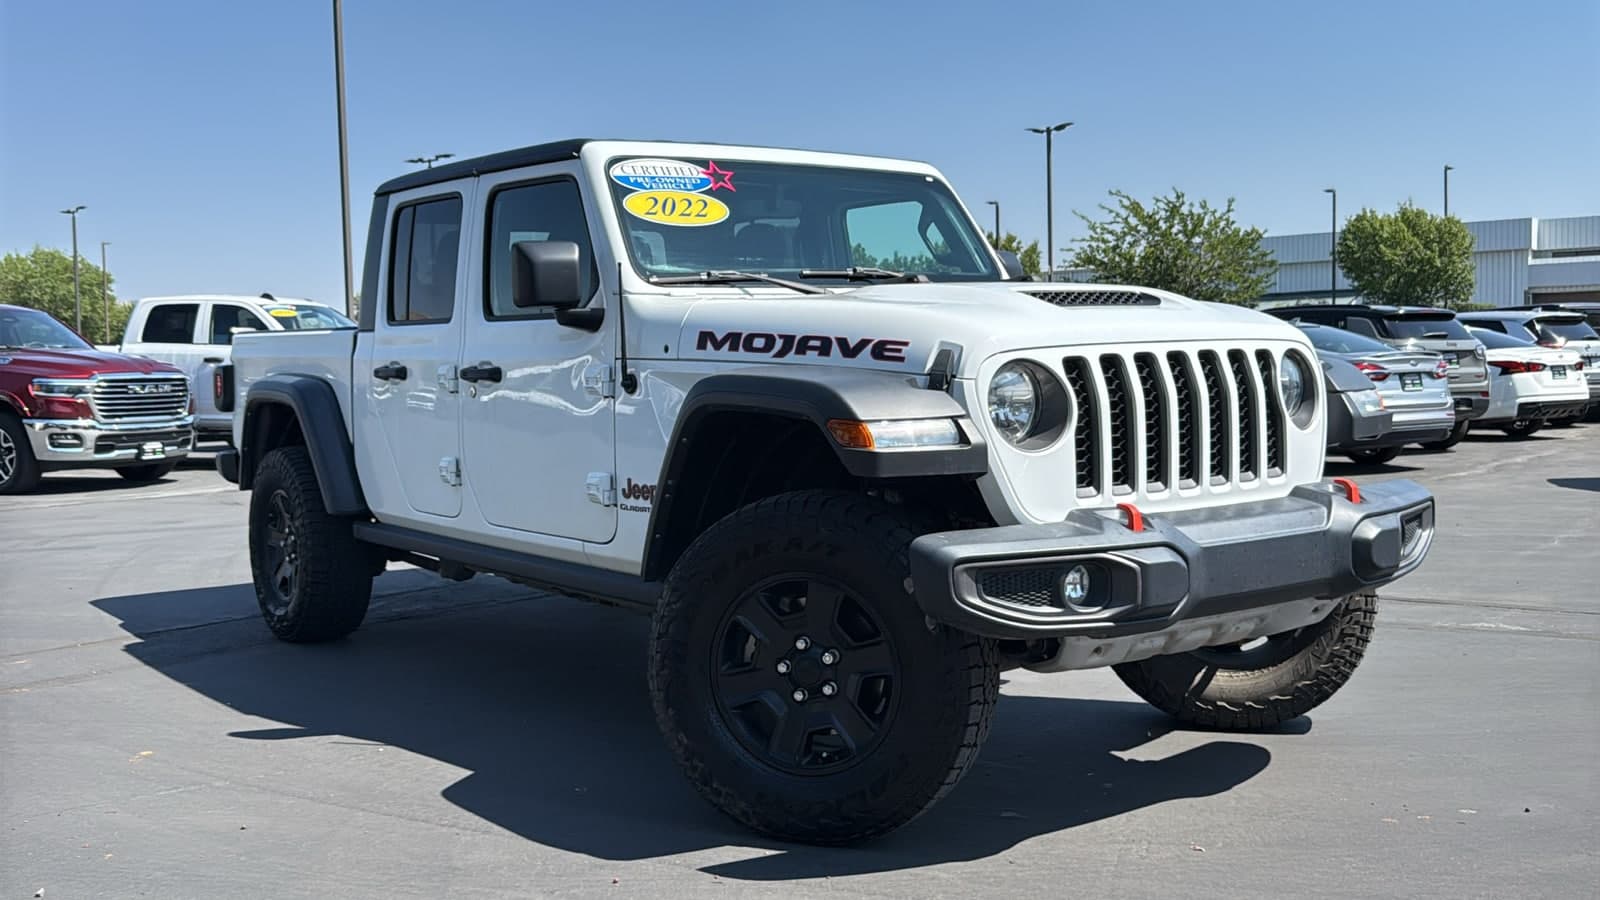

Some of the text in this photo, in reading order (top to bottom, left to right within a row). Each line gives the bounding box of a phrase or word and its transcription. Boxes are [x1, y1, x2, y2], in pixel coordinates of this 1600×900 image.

[620, 164, 700, 177] CERTIFIED
[629, 176, 701, 185] PRE-OWNED
[643, 181, 694, 190] VEHICLE
[644, 196, 709, 218] 2022
[696, 329, 912, 364] MOJAVE
[621, 477, 657, 505] Jeep
[620, 503, 651, 513] GLADIAT
